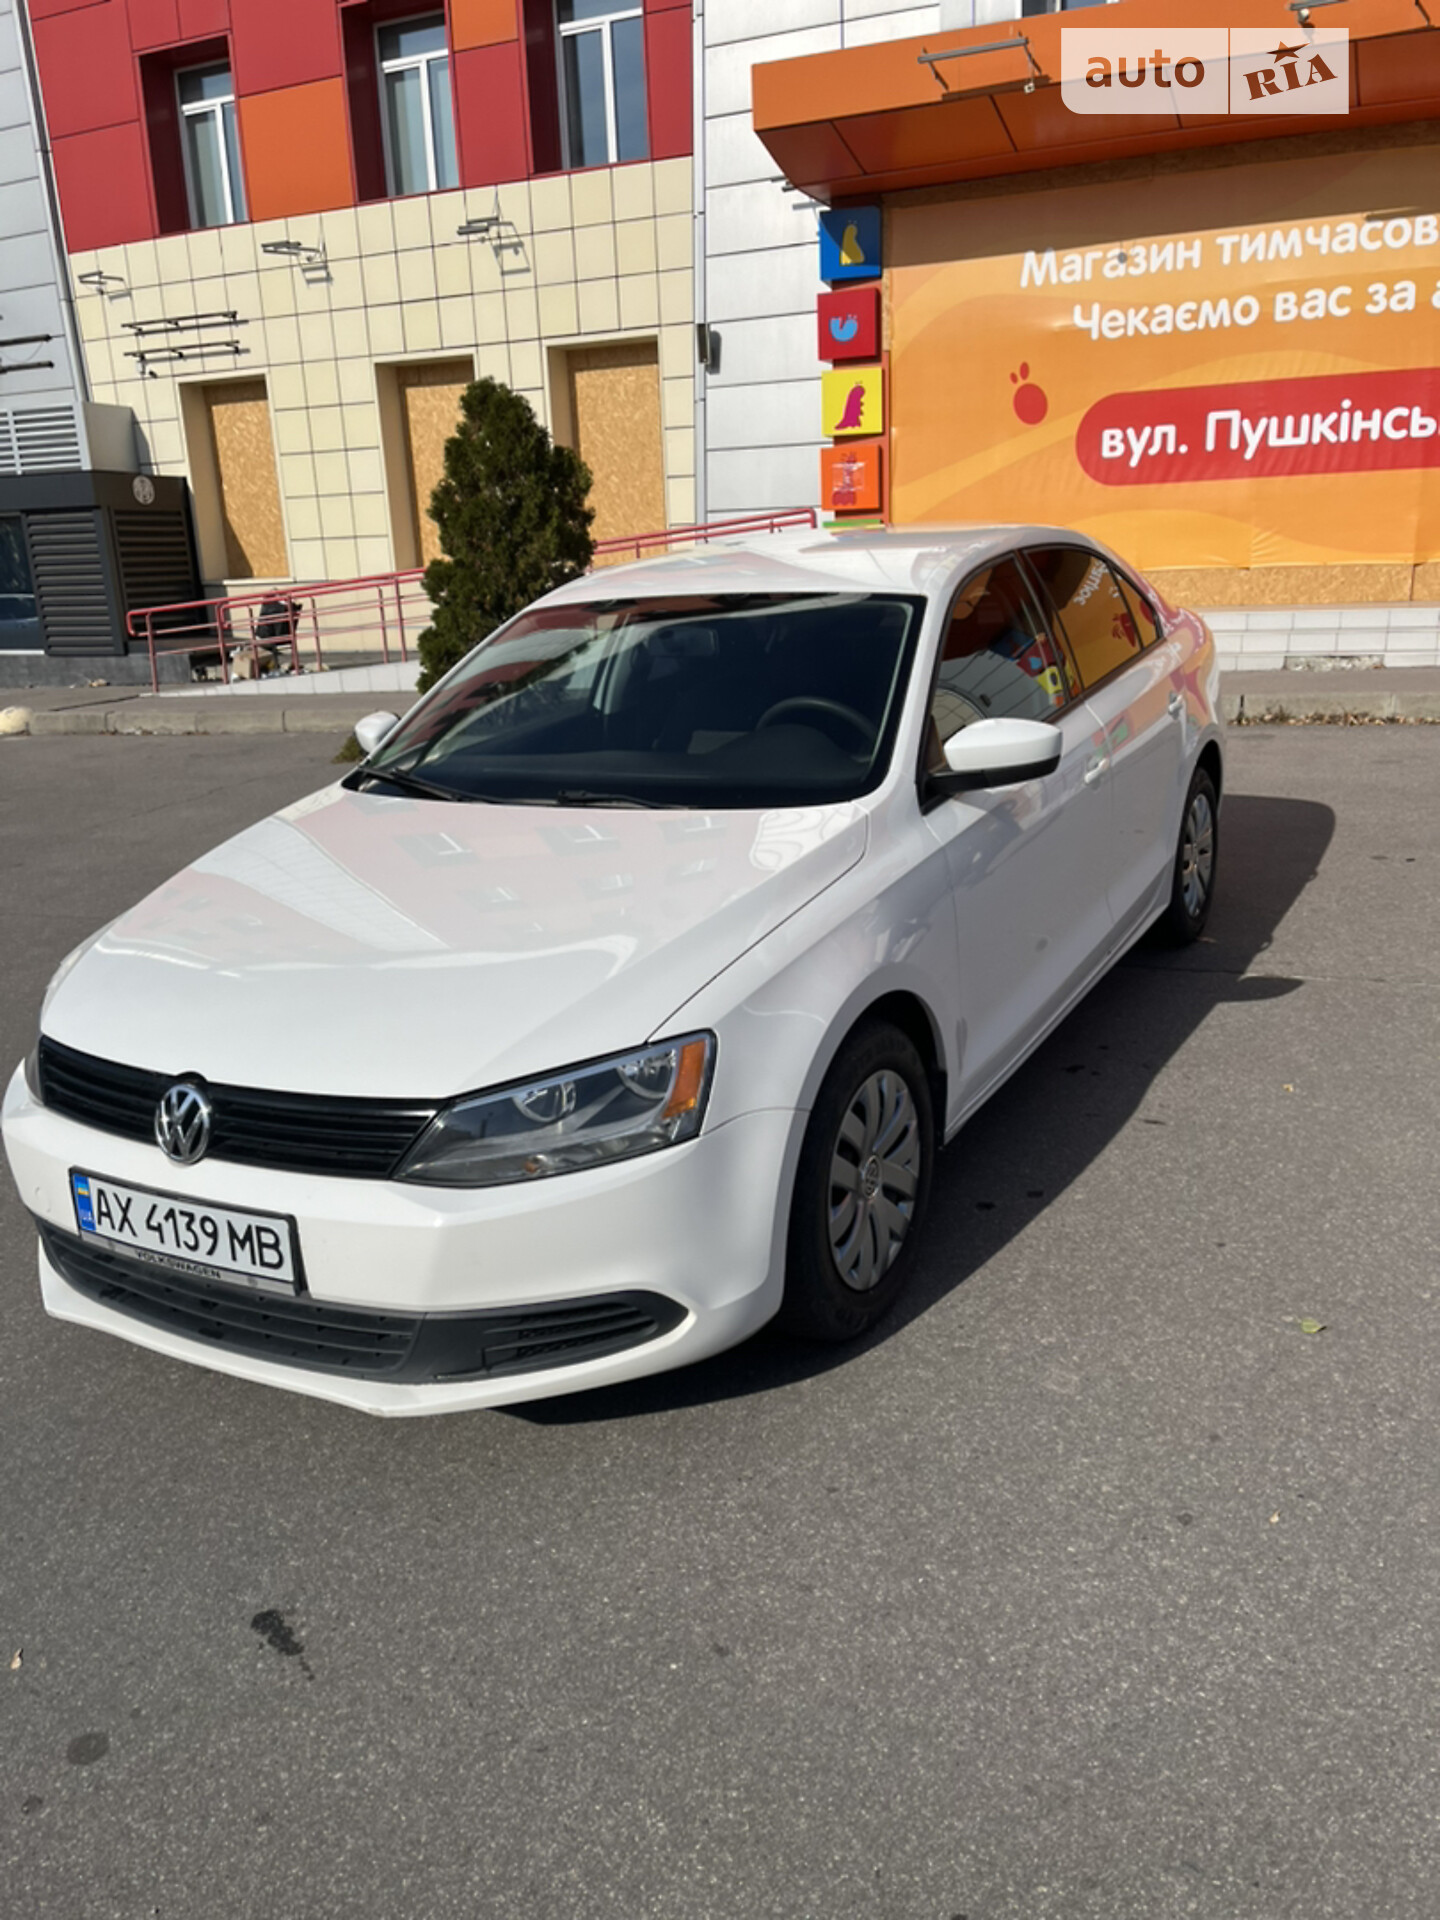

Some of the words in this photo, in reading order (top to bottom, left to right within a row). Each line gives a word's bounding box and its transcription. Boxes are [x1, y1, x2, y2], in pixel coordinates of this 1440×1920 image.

[1020, 238, 1202, 288] Магазин
[1216, 214, 1439, 265] тимчасов
[1072, 293, 1260, 341] Чекаємо
[1273, 284, 1352, 323] вас
[1364, 279, 1417, 314] за
[1100, 423, 1188, 468] вул.
[1205, 398, 1440, 461] Пушкінсь
[96, 1187, 138, 1238] AX
[145, 1203, 219, 1257] 4139
[226, 1219, 285, 1271] MB
[136, 1251, 222, 1279] VOLKSWAGEN
